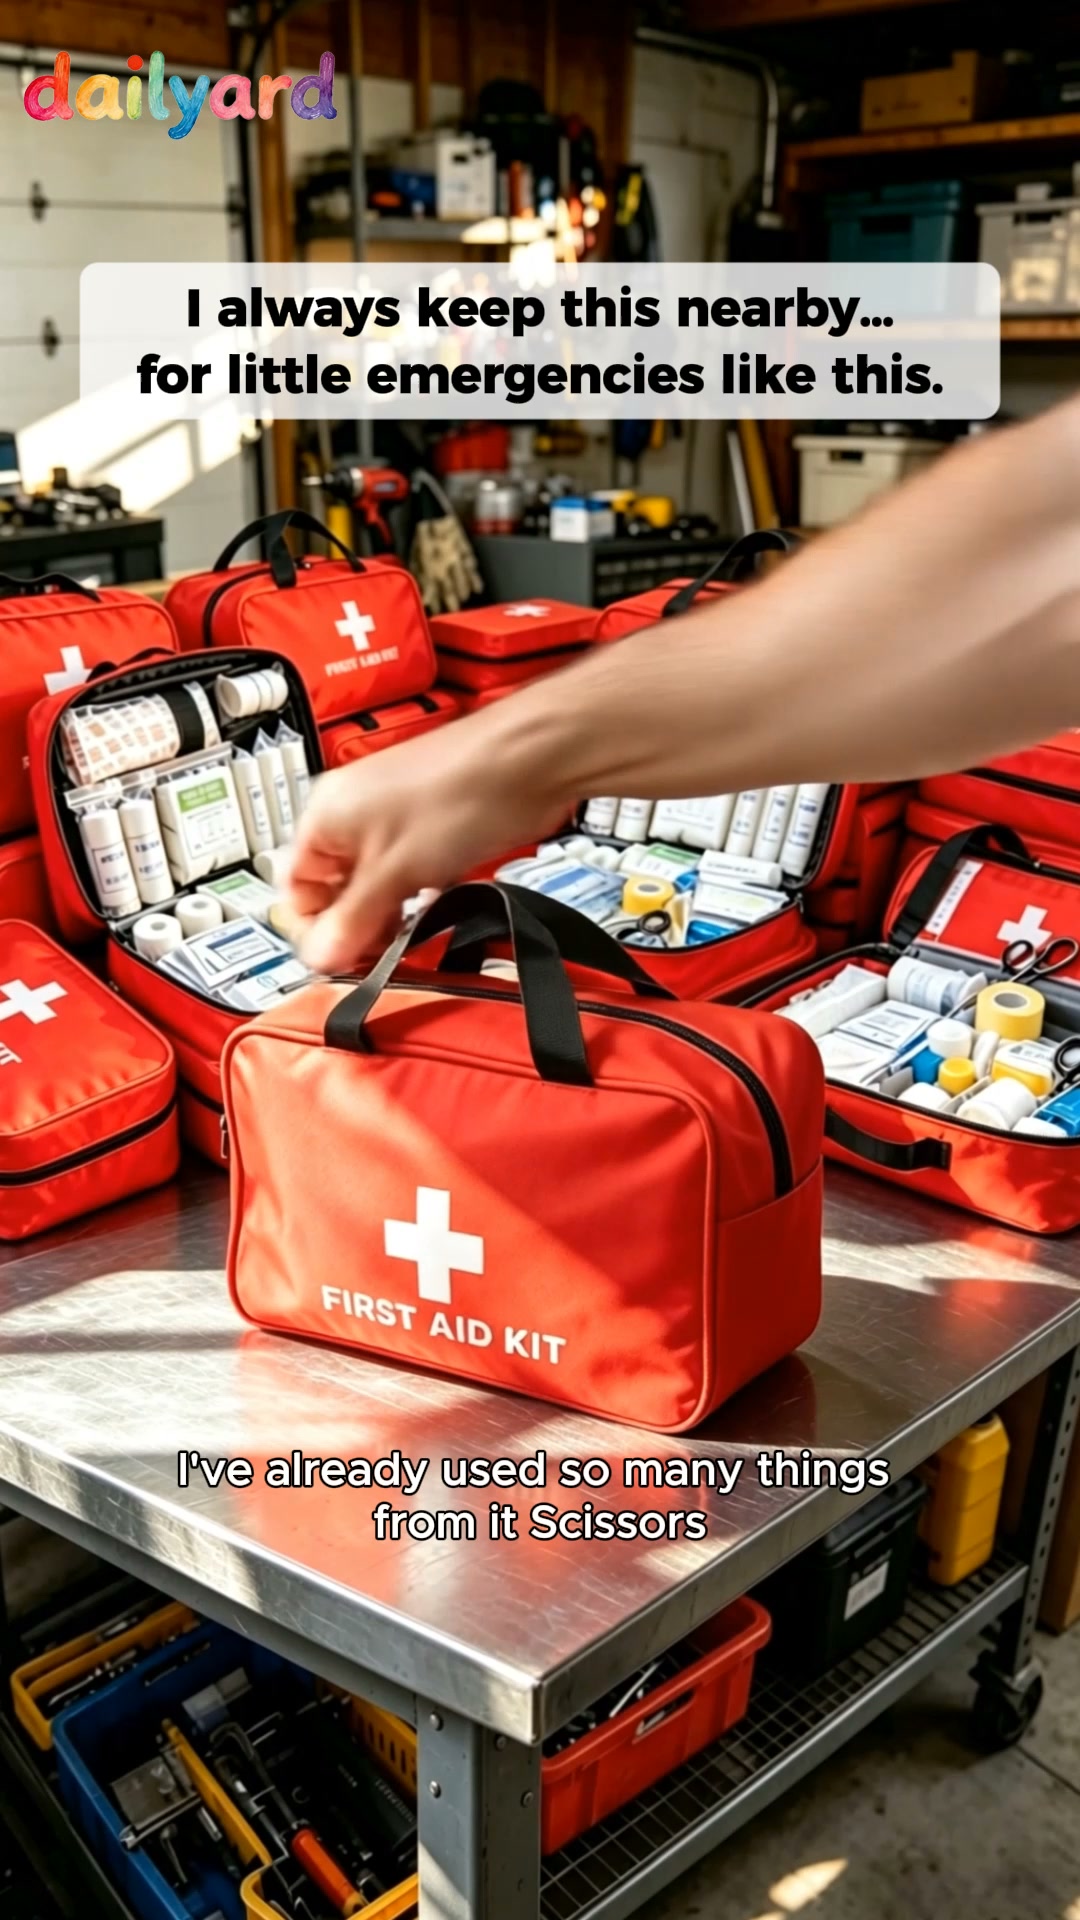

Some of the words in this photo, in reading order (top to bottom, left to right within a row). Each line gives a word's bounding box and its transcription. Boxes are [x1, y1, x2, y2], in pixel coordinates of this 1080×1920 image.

[320, 1284, 417, 1331] FIRST
[429, 1311, 493, 1348] AID
[504, 1326, 567, 1365] KIT
